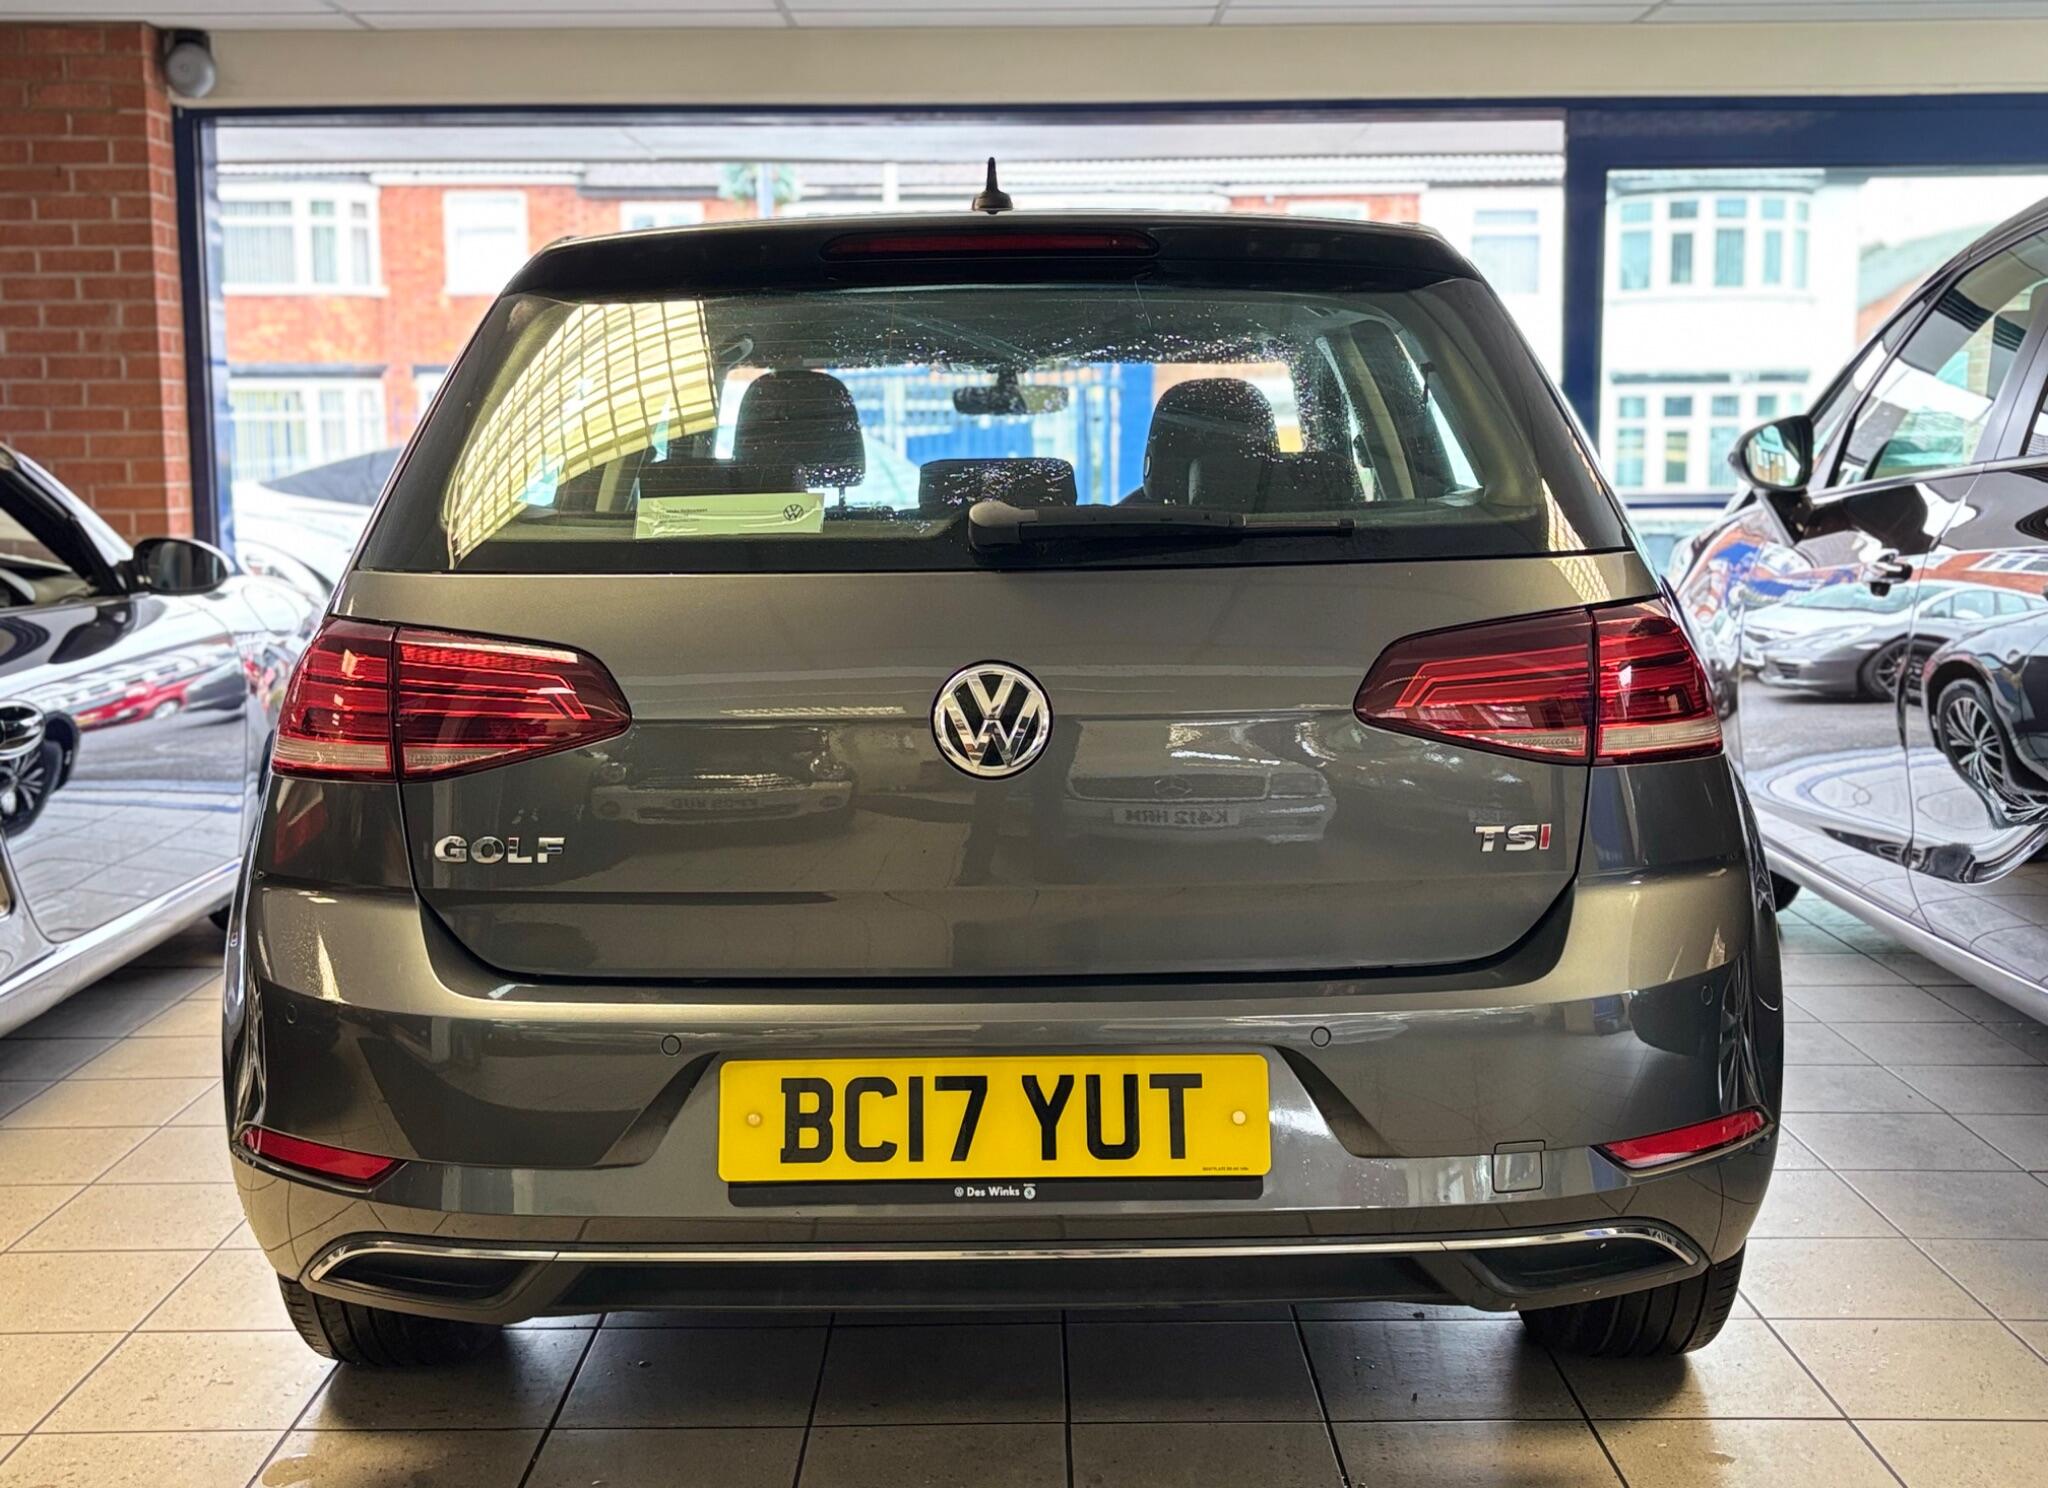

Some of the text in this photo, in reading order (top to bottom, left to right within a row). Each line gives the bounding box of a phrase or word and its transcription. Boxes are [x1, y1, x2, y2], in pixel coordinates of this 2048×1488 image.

[934, 663, 1050, 777] VW
[434, 835, 566, 864] GOLF
[1474, 823, 1552, 852] TSI
[780, 1073, 1203, 1164] BC17 YUT
[966, 1187, 986, 1197] Des
[988, 1186, 1020, 1196] Winks
